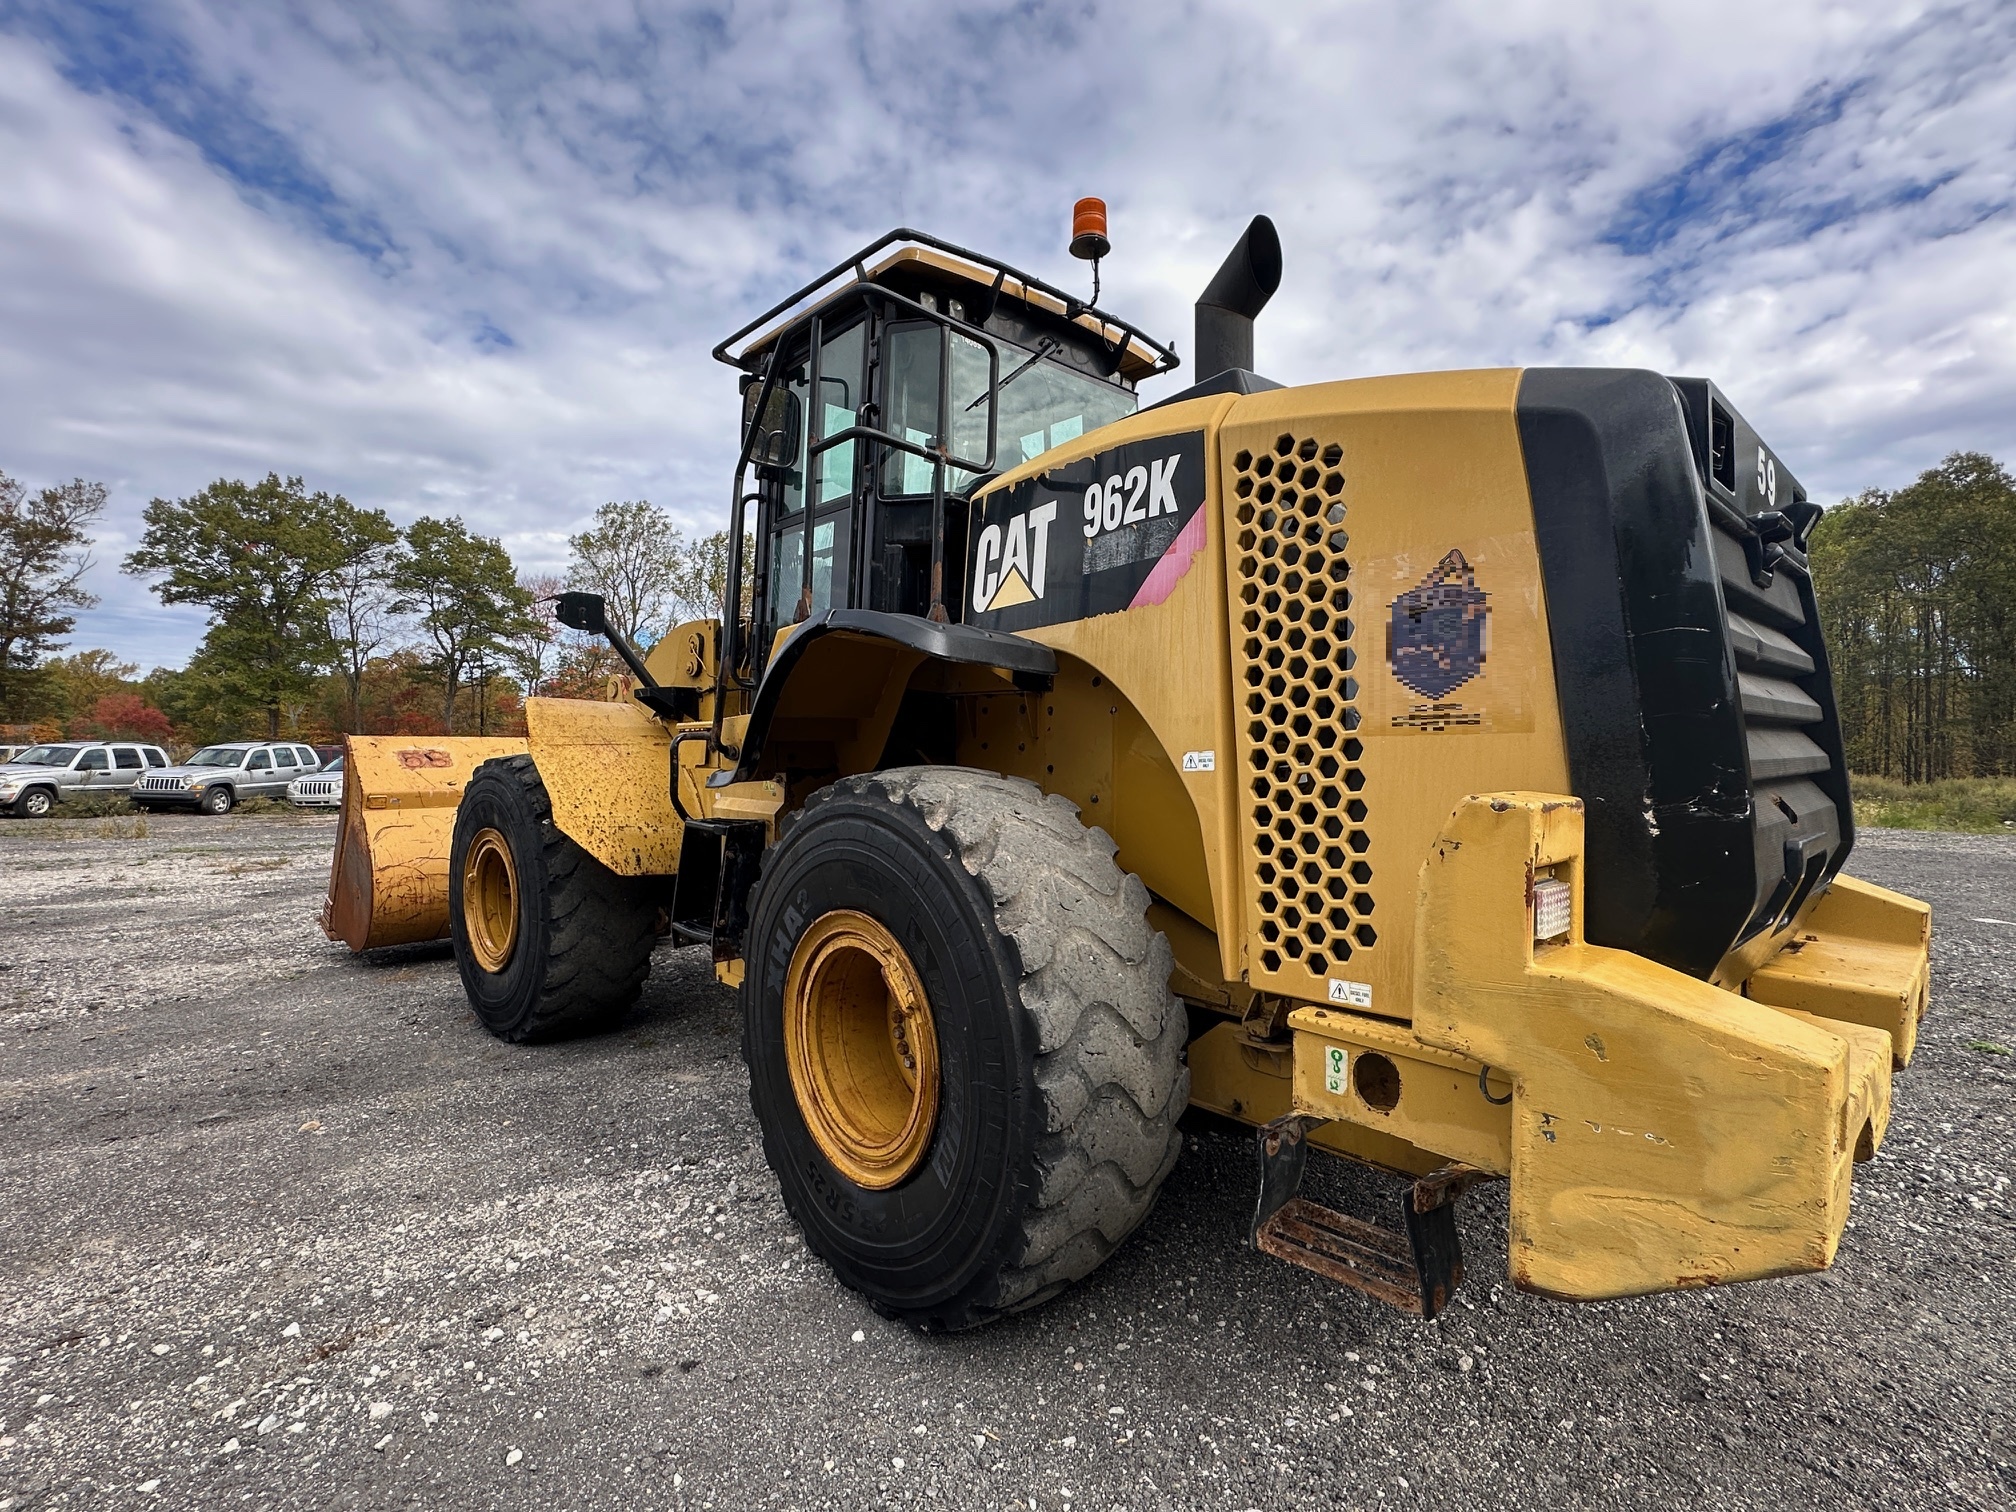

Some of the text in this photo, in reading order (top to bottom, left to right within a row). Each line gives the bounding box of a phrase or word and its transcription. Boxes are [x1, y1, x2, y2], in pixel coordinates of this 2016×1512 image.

[1083, 454, 1182, 538] 962K
[1757, 446, 1776, 507] 59
[973, 500, 1058, 613] CAT
